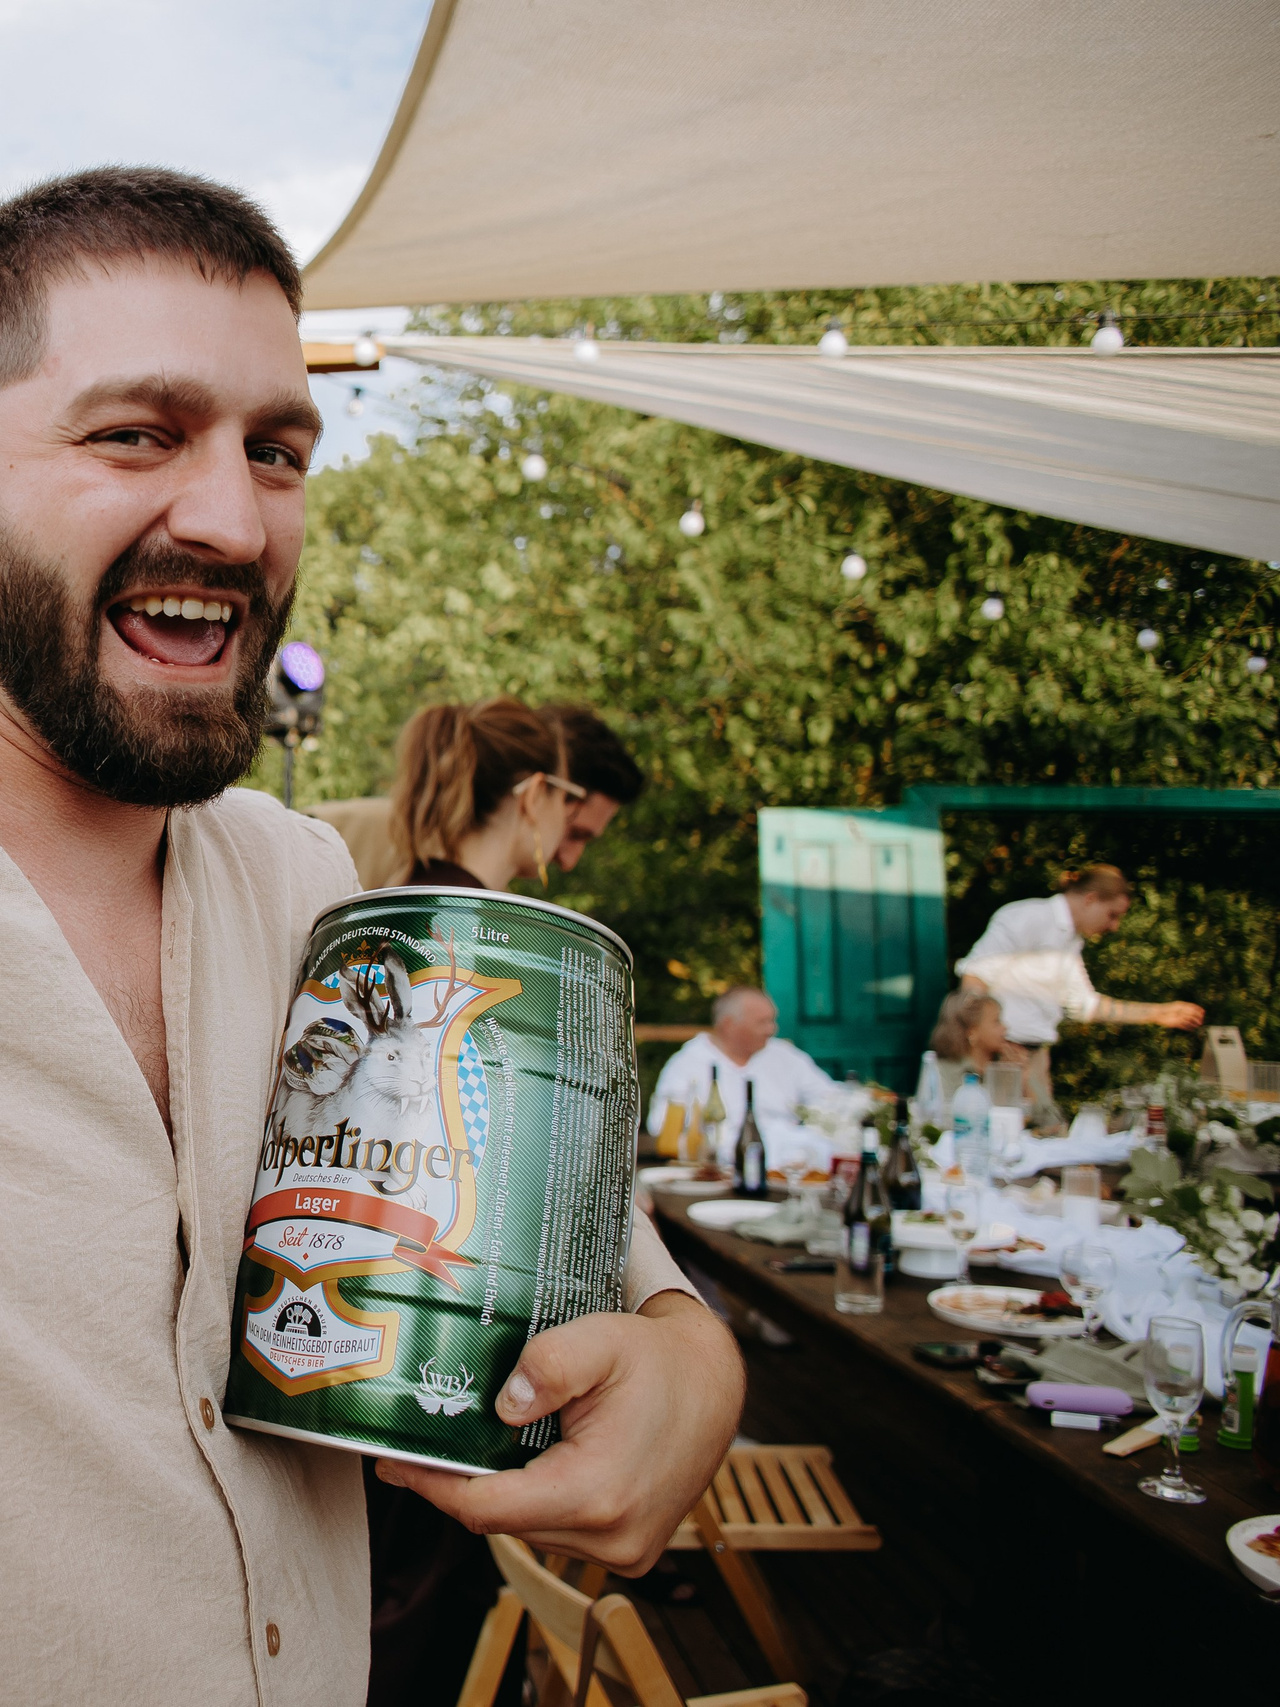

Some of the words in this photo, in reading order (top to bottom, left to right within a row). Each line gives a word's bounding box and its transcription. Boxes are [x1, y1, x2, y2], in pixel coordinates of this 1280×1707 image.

[341, 926, 390, 943] DEUTSCHER
[389, 929, 437, 964] STANDARD
[485, 1017, 508, 1055] Höchste
[501, 1057, 517, 1112] Güteklasse
[504, 1115, 515, 1132] mit
[550, 1074, 562, 1137] (ВОЛЬПЕРТИНГЕР
[262, 1110, 475, 1196] olpertinger
[498, 1135, 513, 1186] erlesenen
[548, 1140, 557, 1162] LAGER
[293, 1172, 332, 1183] Deutsches
[333, 1174, 352, 1184] Bier
[542, 1164, 555, 1220] WOLPERTINGER
[295, 1193, 340, 1214] Lager
[493, 1188, 509, 1230] Zutaten
[278, 1225, 309, 1248] Seit
[308, 1231, 345, 1250] 1878
[489, 1239, 503, 1262] Echt
[486, 1264, 499, 1286] und
[534, 1222, 549, 1296] ПАСТЕРИЗОВАННОЕ
[277, 1295, 313, 1314] DEUTSCHEN
[314, 1303, 328, 1335] BRAUER
[480, 1288, 498, 1326] Ehrlich
[526, 1298, 542, 1342] РОВАННОЕ
[259, 1329, 271, 1344] DEM
[271, 1332, 332, 1354] REINHEITSGEBOT
[333, 1337, 376, 1354] GEBRAUT
[270, 1350, 306, 1366] DEUTSCHES
[307, 1357, 325, 1368] BIER
